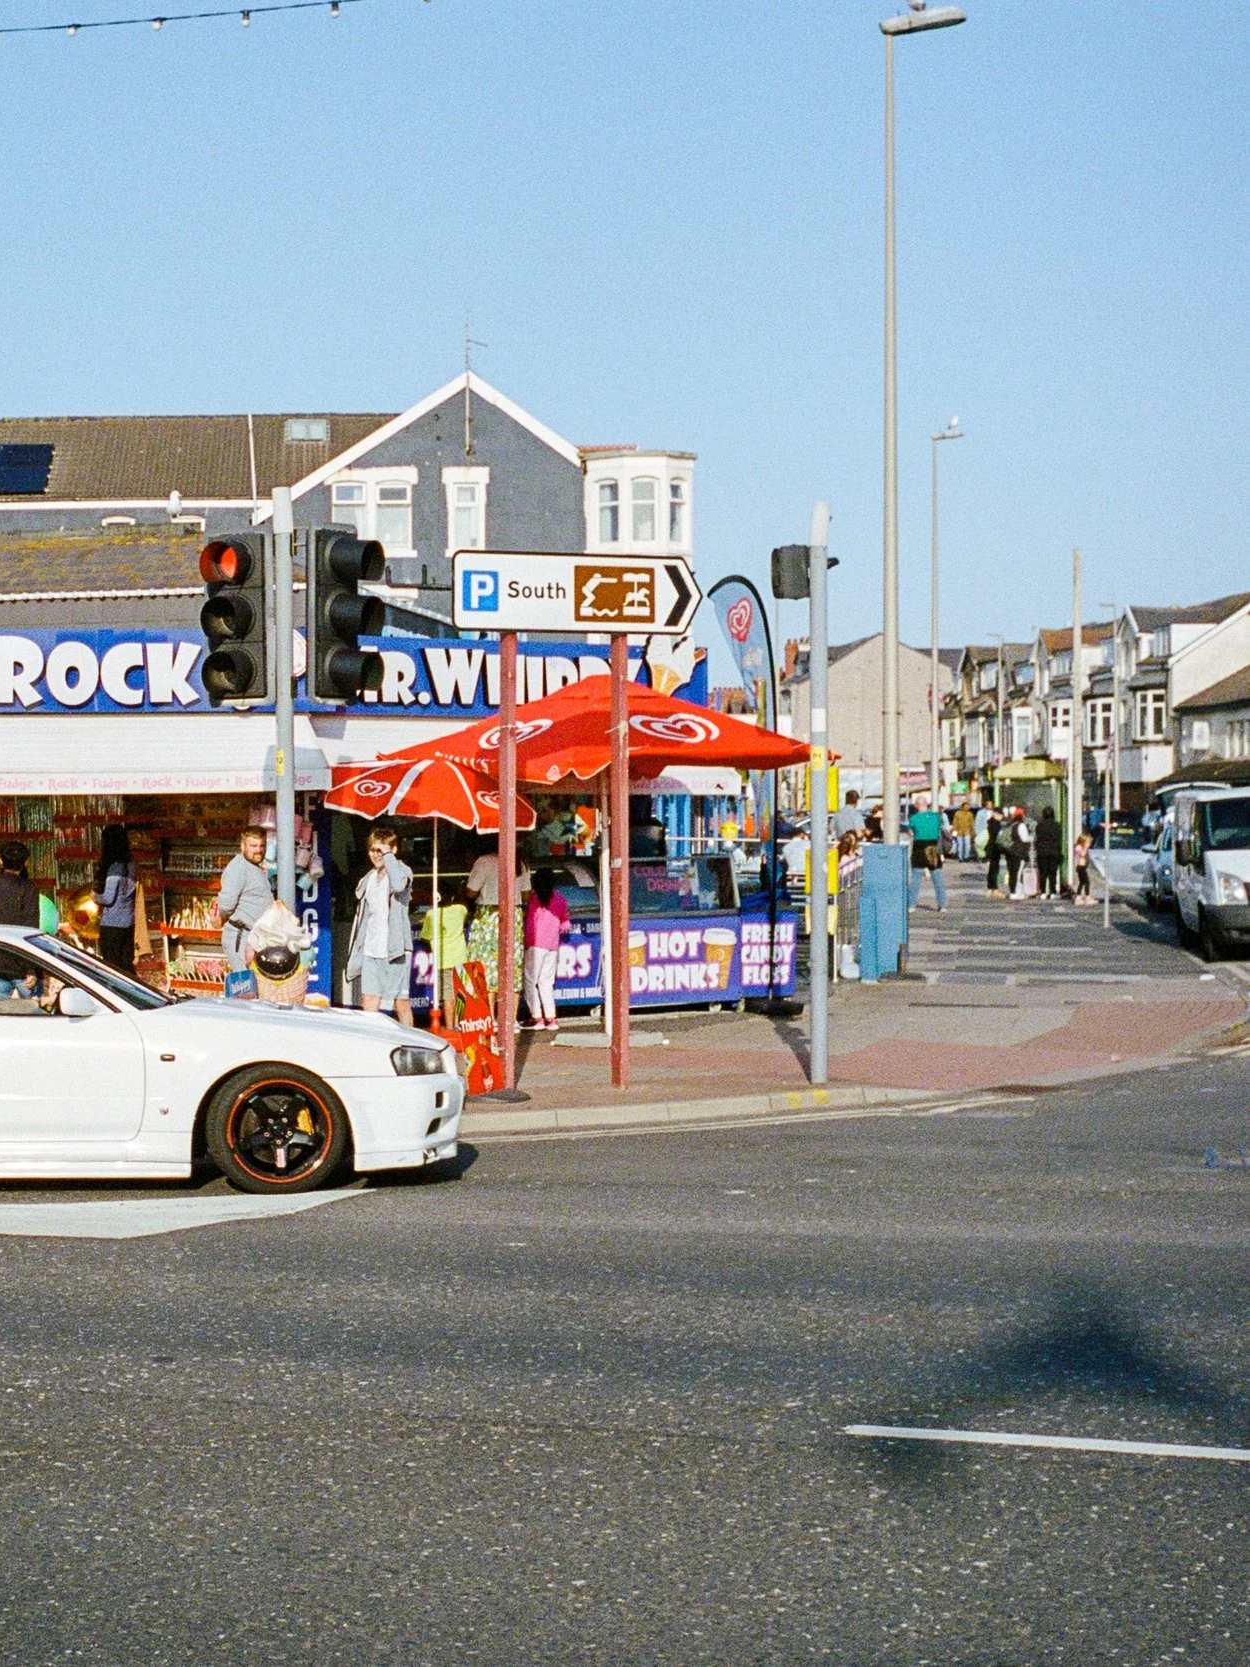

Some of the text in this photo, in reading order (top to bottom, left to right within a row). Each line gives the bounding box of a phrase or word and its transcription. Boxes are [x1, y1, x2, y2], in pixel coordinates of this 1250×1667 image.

[507, 580, 567, 600] South
[648, 931, 701, 959] HOT
[630, 963, 720, 993] DRINKS
[460, 1016, 492, 1034] Thirsty?
